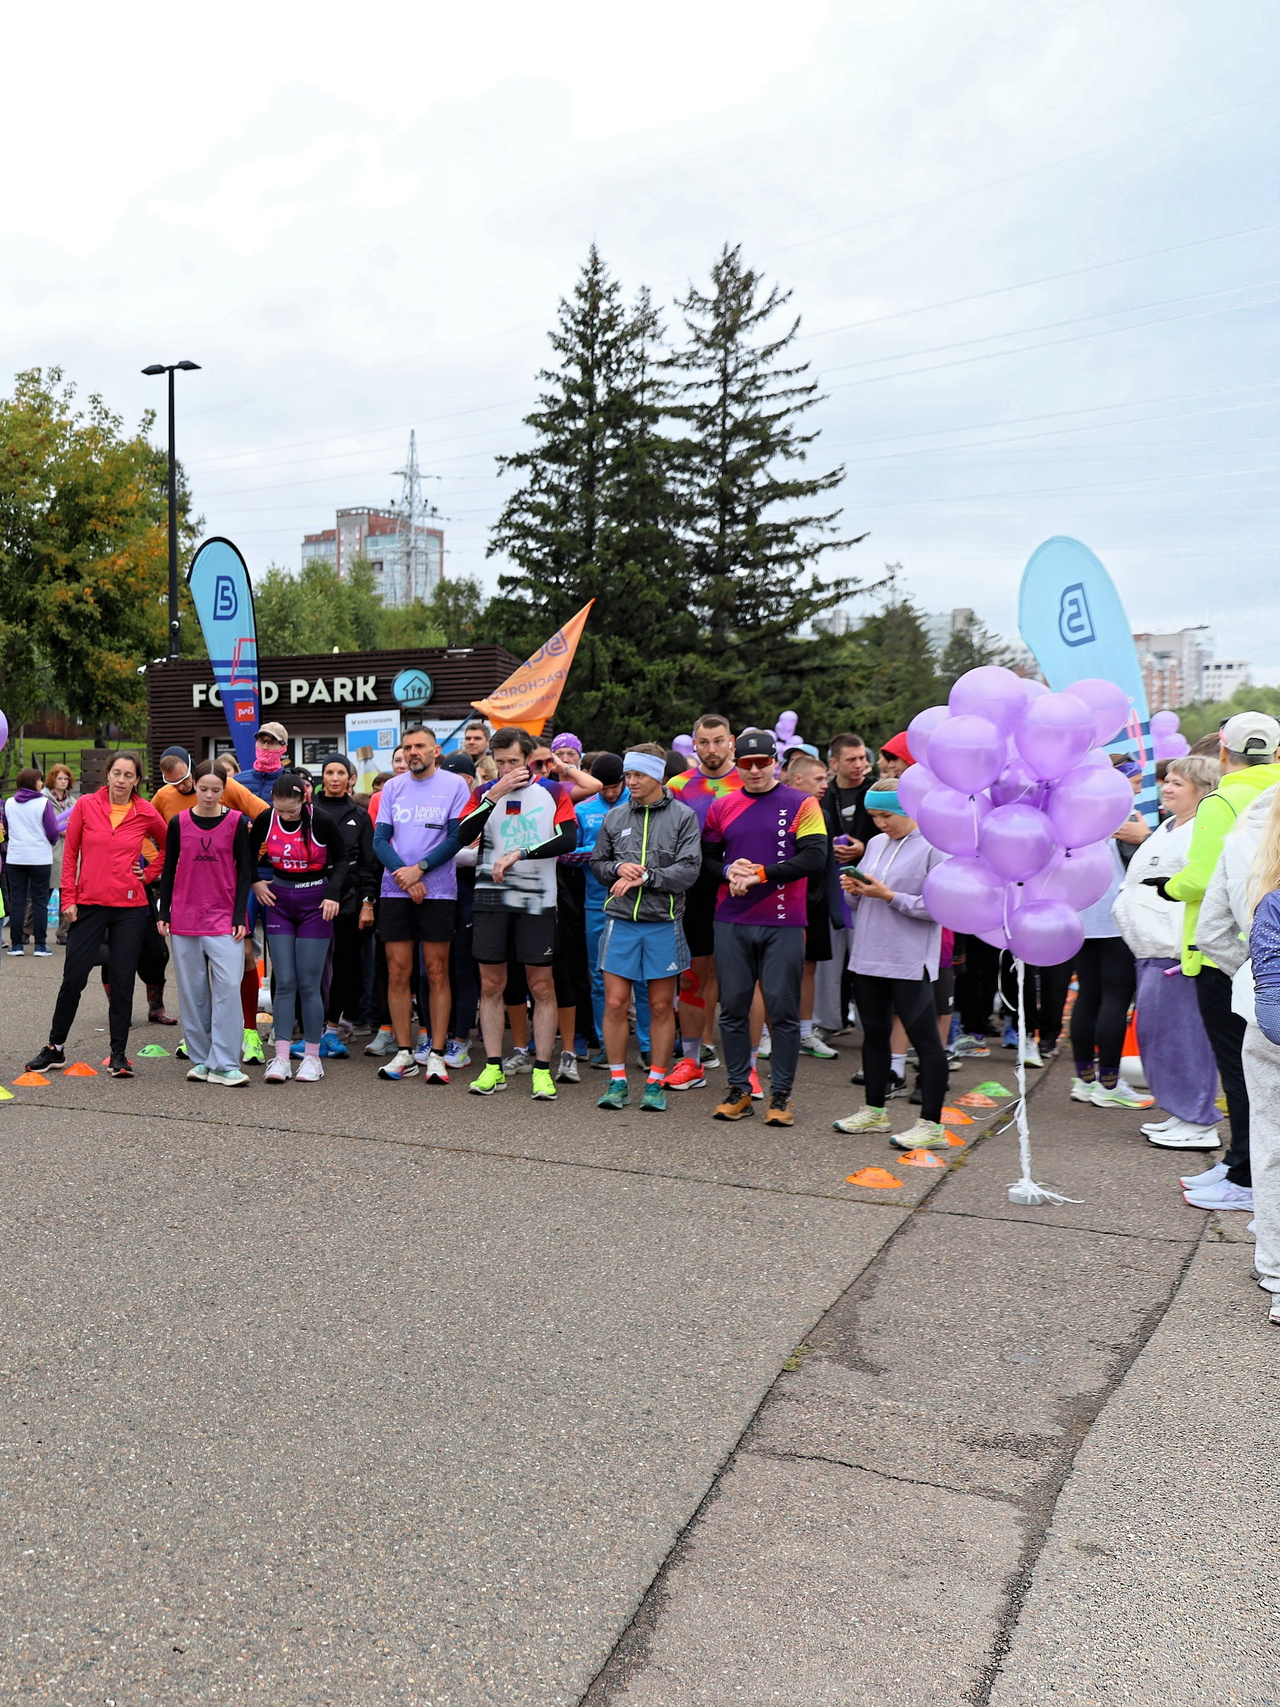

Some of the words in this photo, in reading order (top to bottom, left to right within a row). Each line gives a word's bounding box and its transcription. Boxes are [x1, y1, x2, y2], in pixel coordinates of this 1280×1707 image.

[192, 680, 280, 709] FOD
[290, 675, 378, 704] PARK
[283, 843, 292, 857] 2
[282, 859, 308, 869] ВТБ
[777, 808, 788, 919] КРАСРАФОН
[294, 881, 310, 889] NIKE
